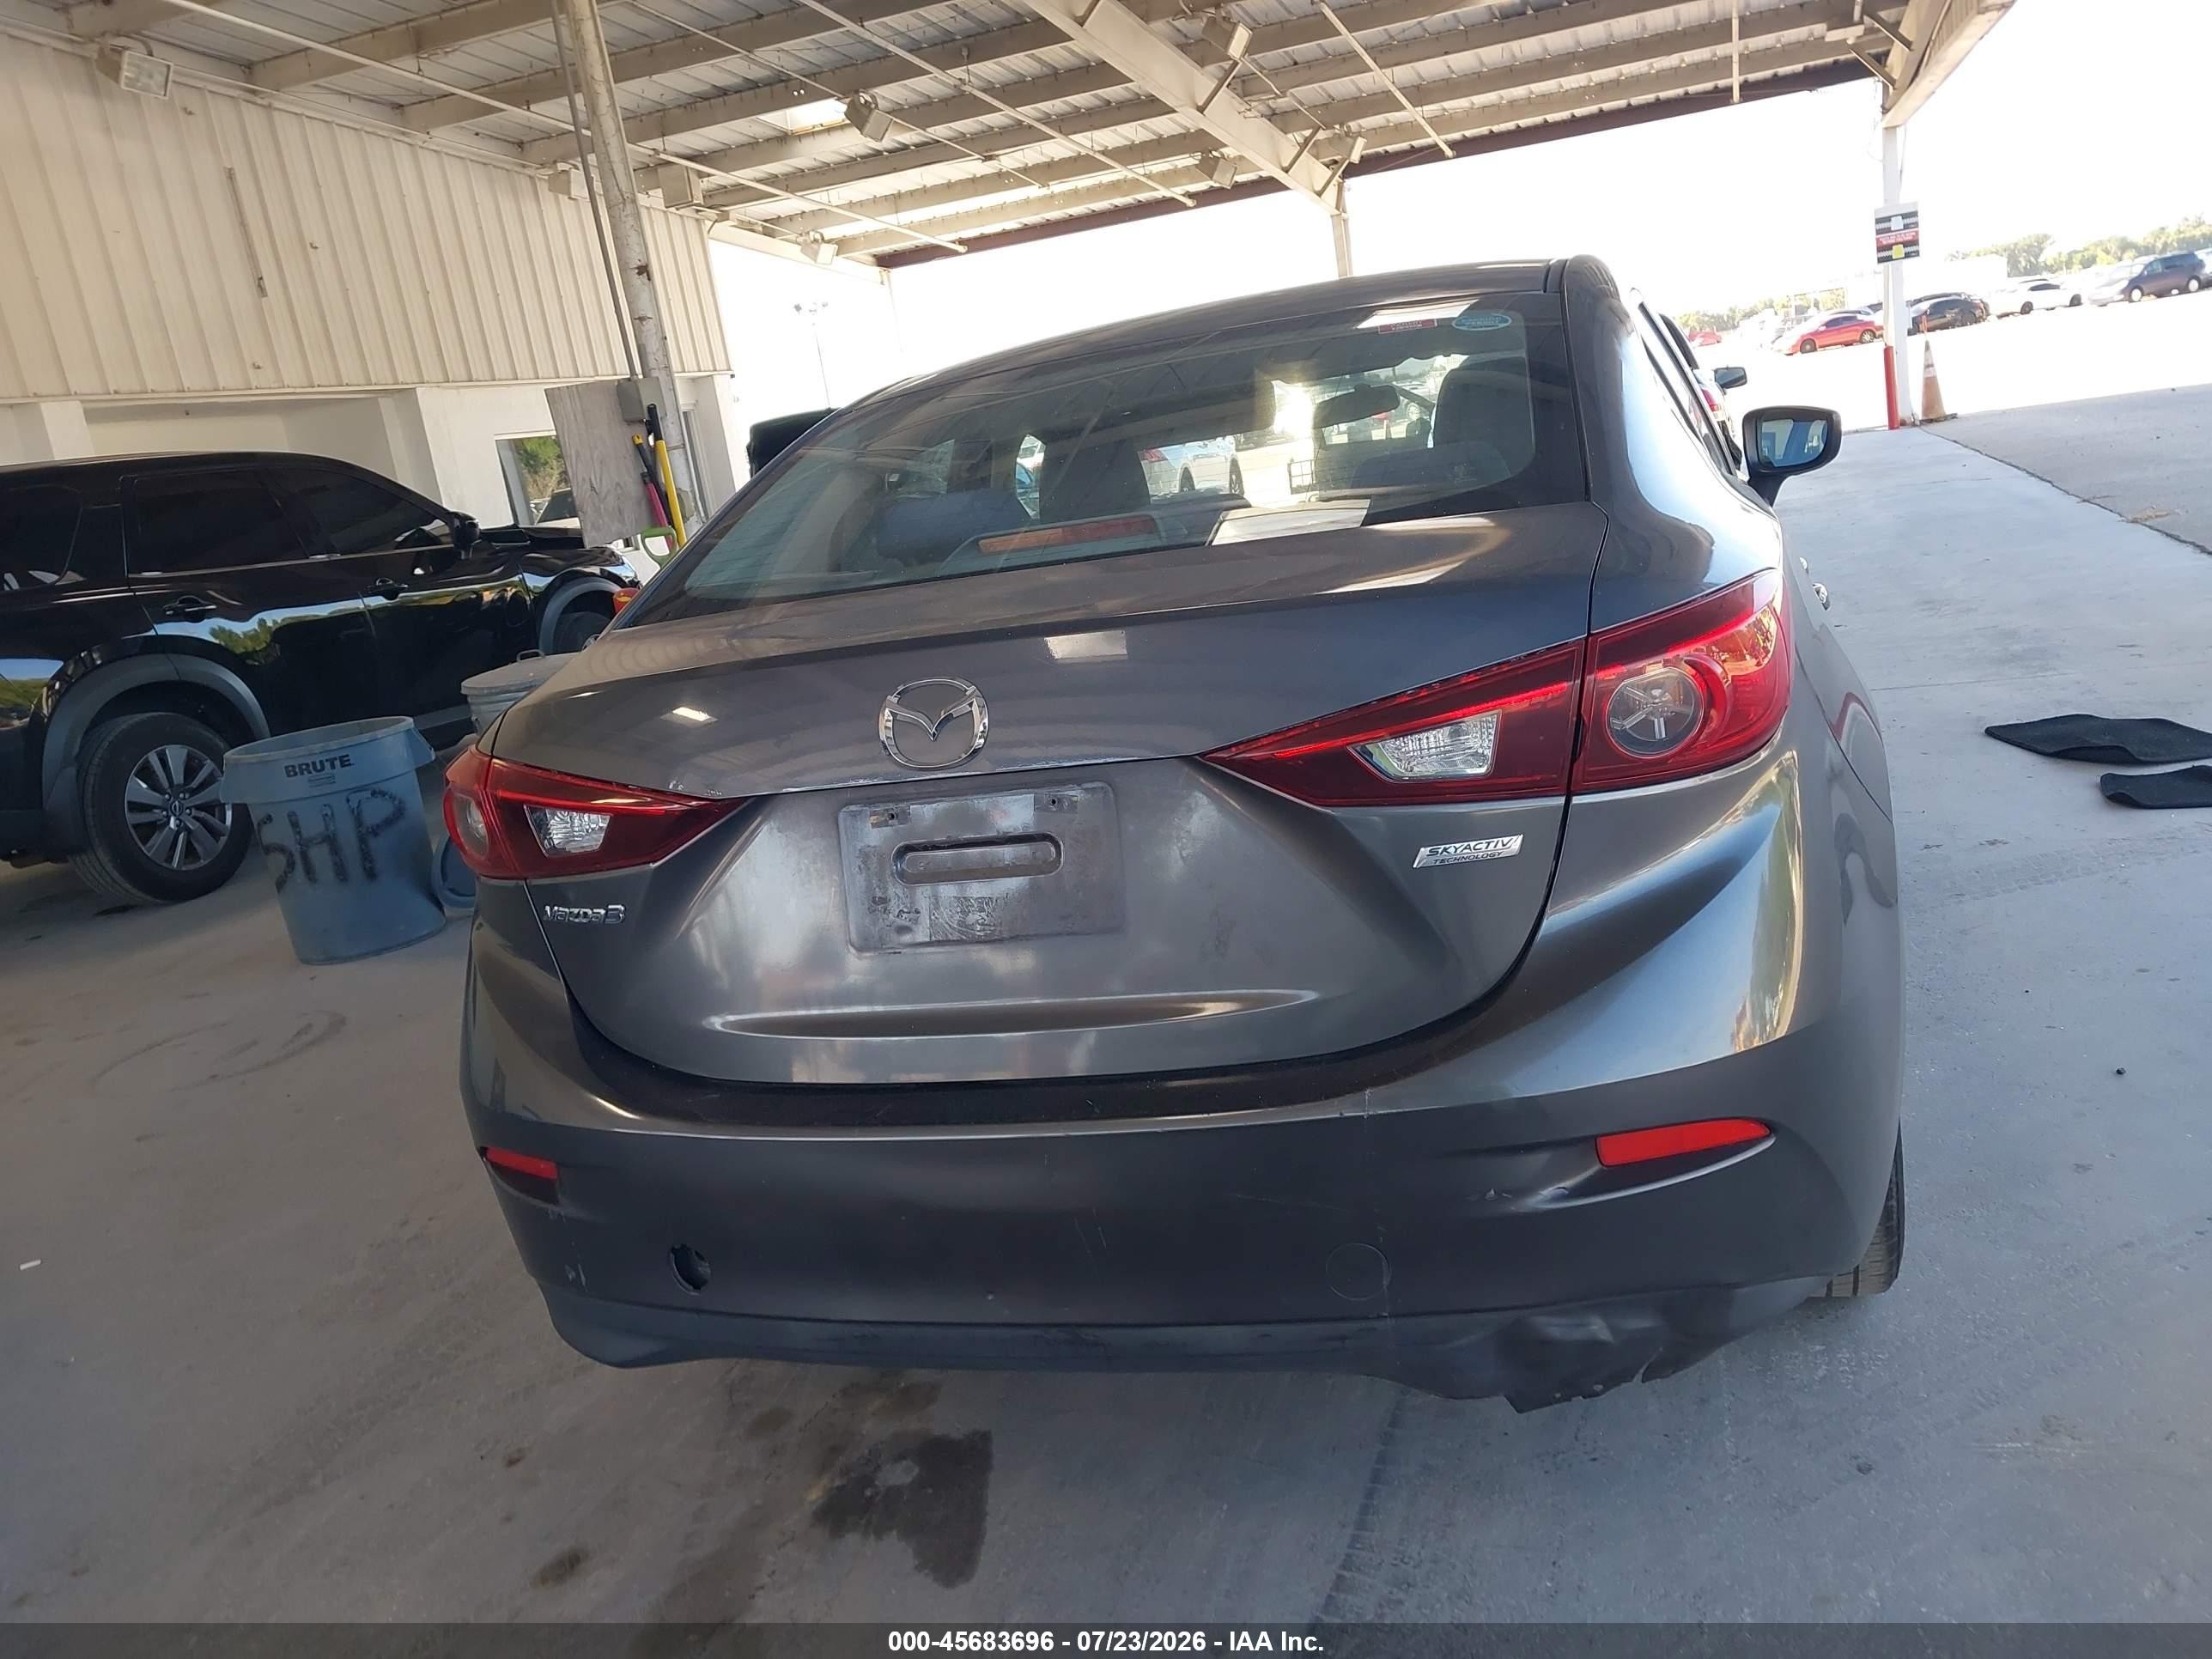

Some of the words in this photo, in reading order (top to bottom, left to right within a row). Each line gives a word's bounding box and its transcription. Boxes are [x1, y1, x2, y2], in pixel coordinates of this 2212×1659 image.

[283, 754, 352, 778] BRUTE
[1425, 837, 1514, 857] SKYACTIV
[1433, 851, 1504, 865] TECHNOLOGY
